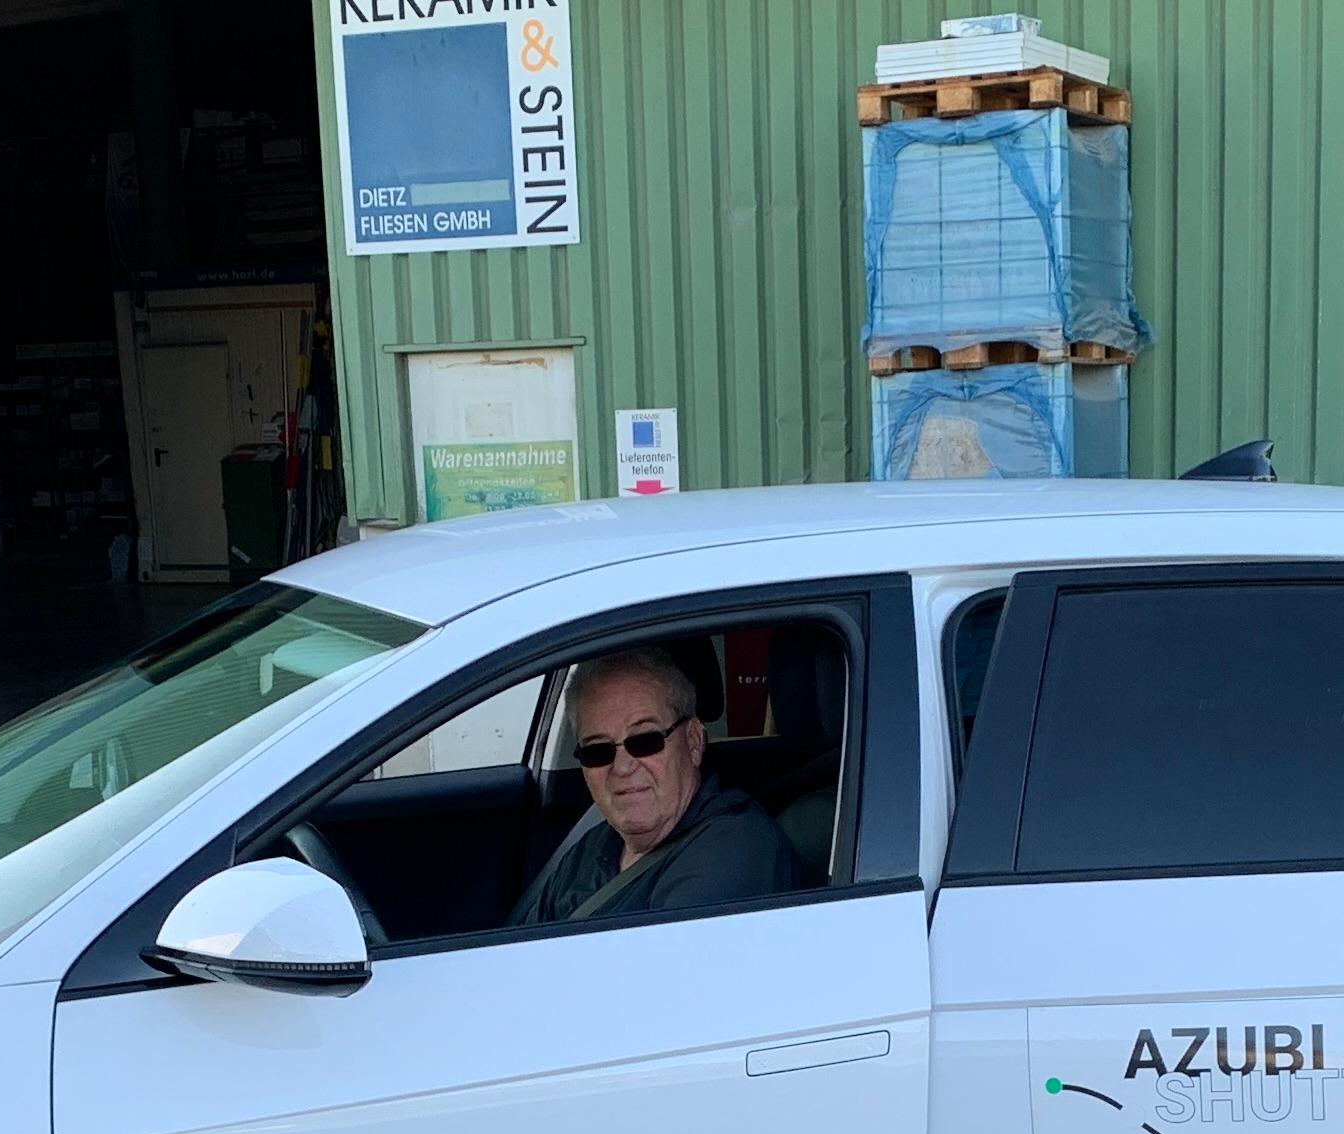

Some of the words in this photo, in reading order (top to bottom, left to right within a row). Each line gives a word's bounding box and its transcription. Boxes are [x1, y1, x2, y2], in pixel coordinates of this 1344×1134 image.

[521, 19, 559, 73] &
[519, 85, 569, 234] STEIN
[359, 187, 407, 207] DIETZ
[360, 212, 428, 236] FLIESEN
[433, 210, 491, 231] GMBH
[430, 444, 567, 468] Warenannahme
[620, 452, 676, 463] Lieferanten-
[632, 464, 664, 475] telefon
[1123, 1024, 1324, 1079] AZUBI
